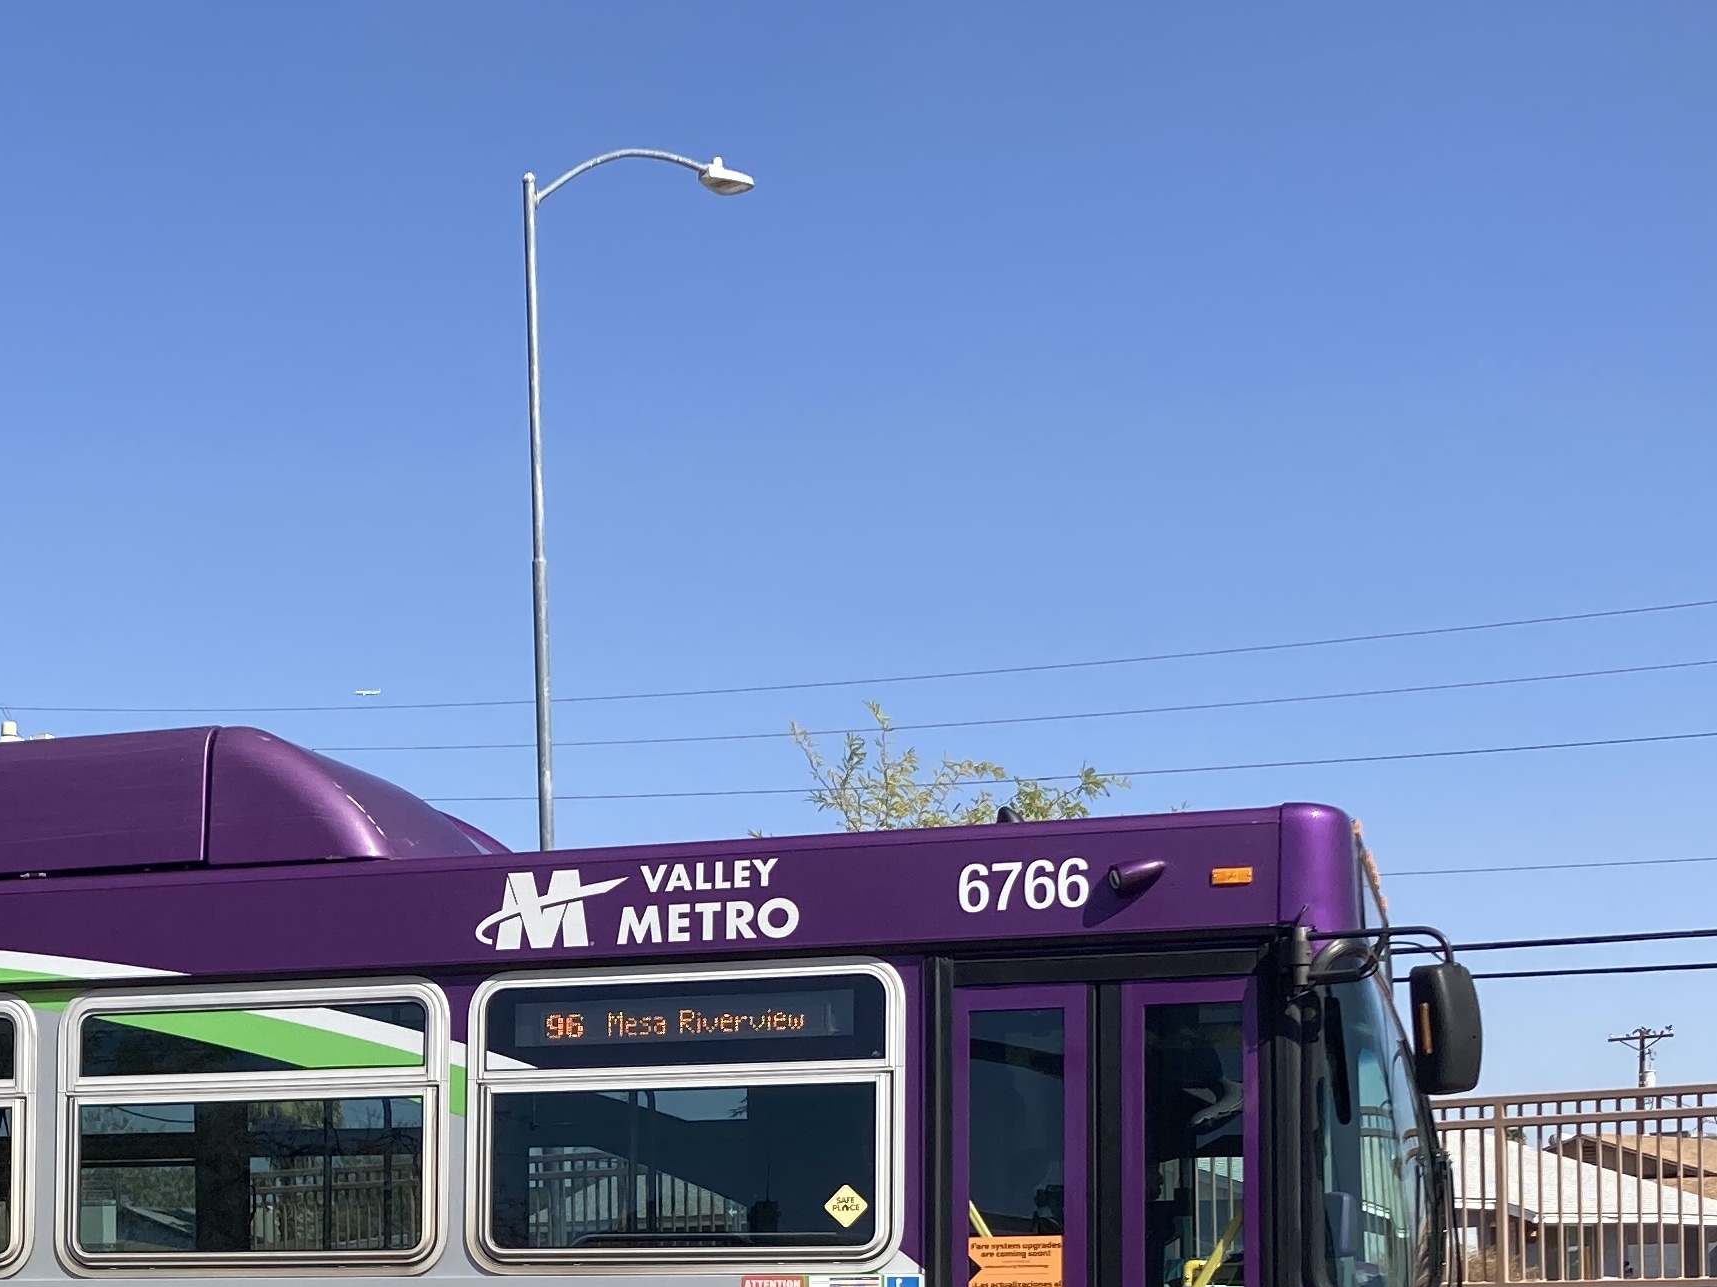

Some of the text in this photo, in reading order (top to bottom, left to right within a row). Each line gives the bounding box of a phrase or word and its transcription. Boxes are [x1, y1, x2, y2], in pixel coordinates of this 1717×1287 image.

[640, 858, 779, 893] VALLEY
[958, 857, 1090, 914] 6766
[616, 897, 800, 945] METRO
[545, 1008, 805, 1039] 96 Mesa Riverview
[836, 1196, 855, 1204] SAFE
[971, 1242, 1062, 1251] Fare system upgrades
[996, 1251, 1027, 1259] coming
